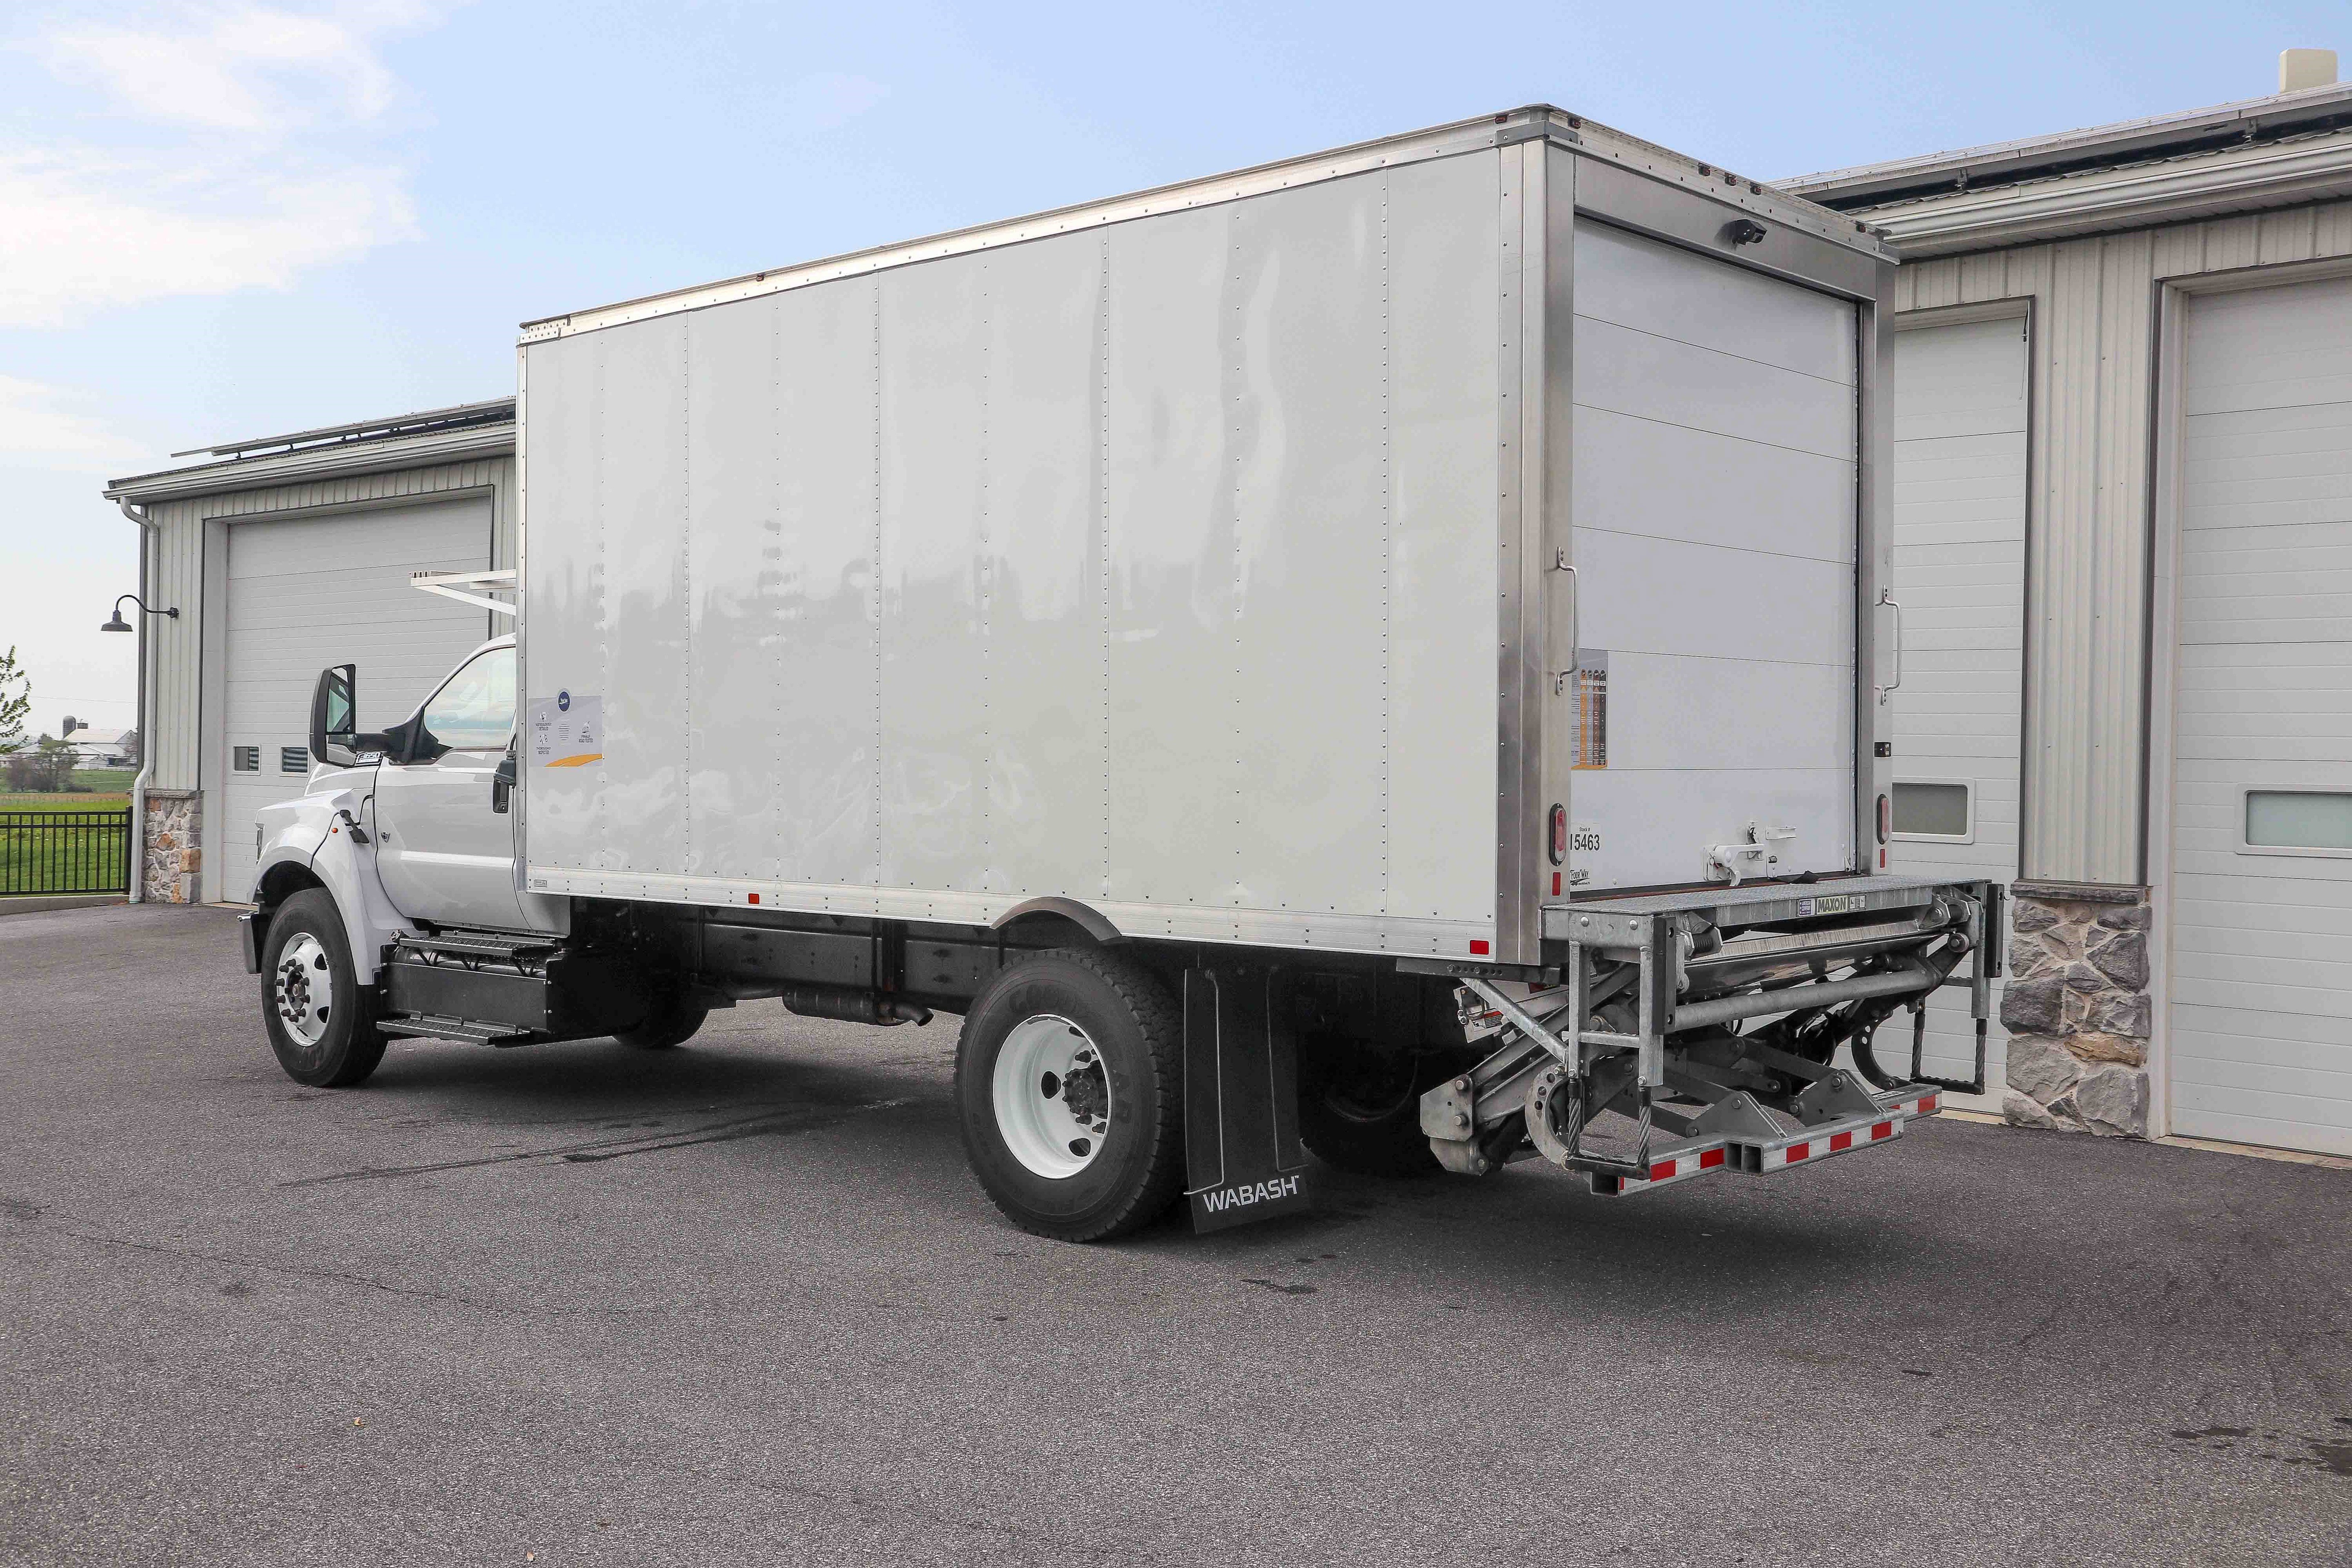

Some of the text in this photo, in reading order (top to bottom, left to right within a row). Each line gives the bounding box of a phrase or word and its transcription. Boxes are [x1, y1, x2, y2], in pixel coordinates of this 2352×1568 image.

[1570, 833, 1600, 851] 15463
[1818, 898, 1846, 913] MAXON
[1203, 1175, 1297, 1212] WABASH
